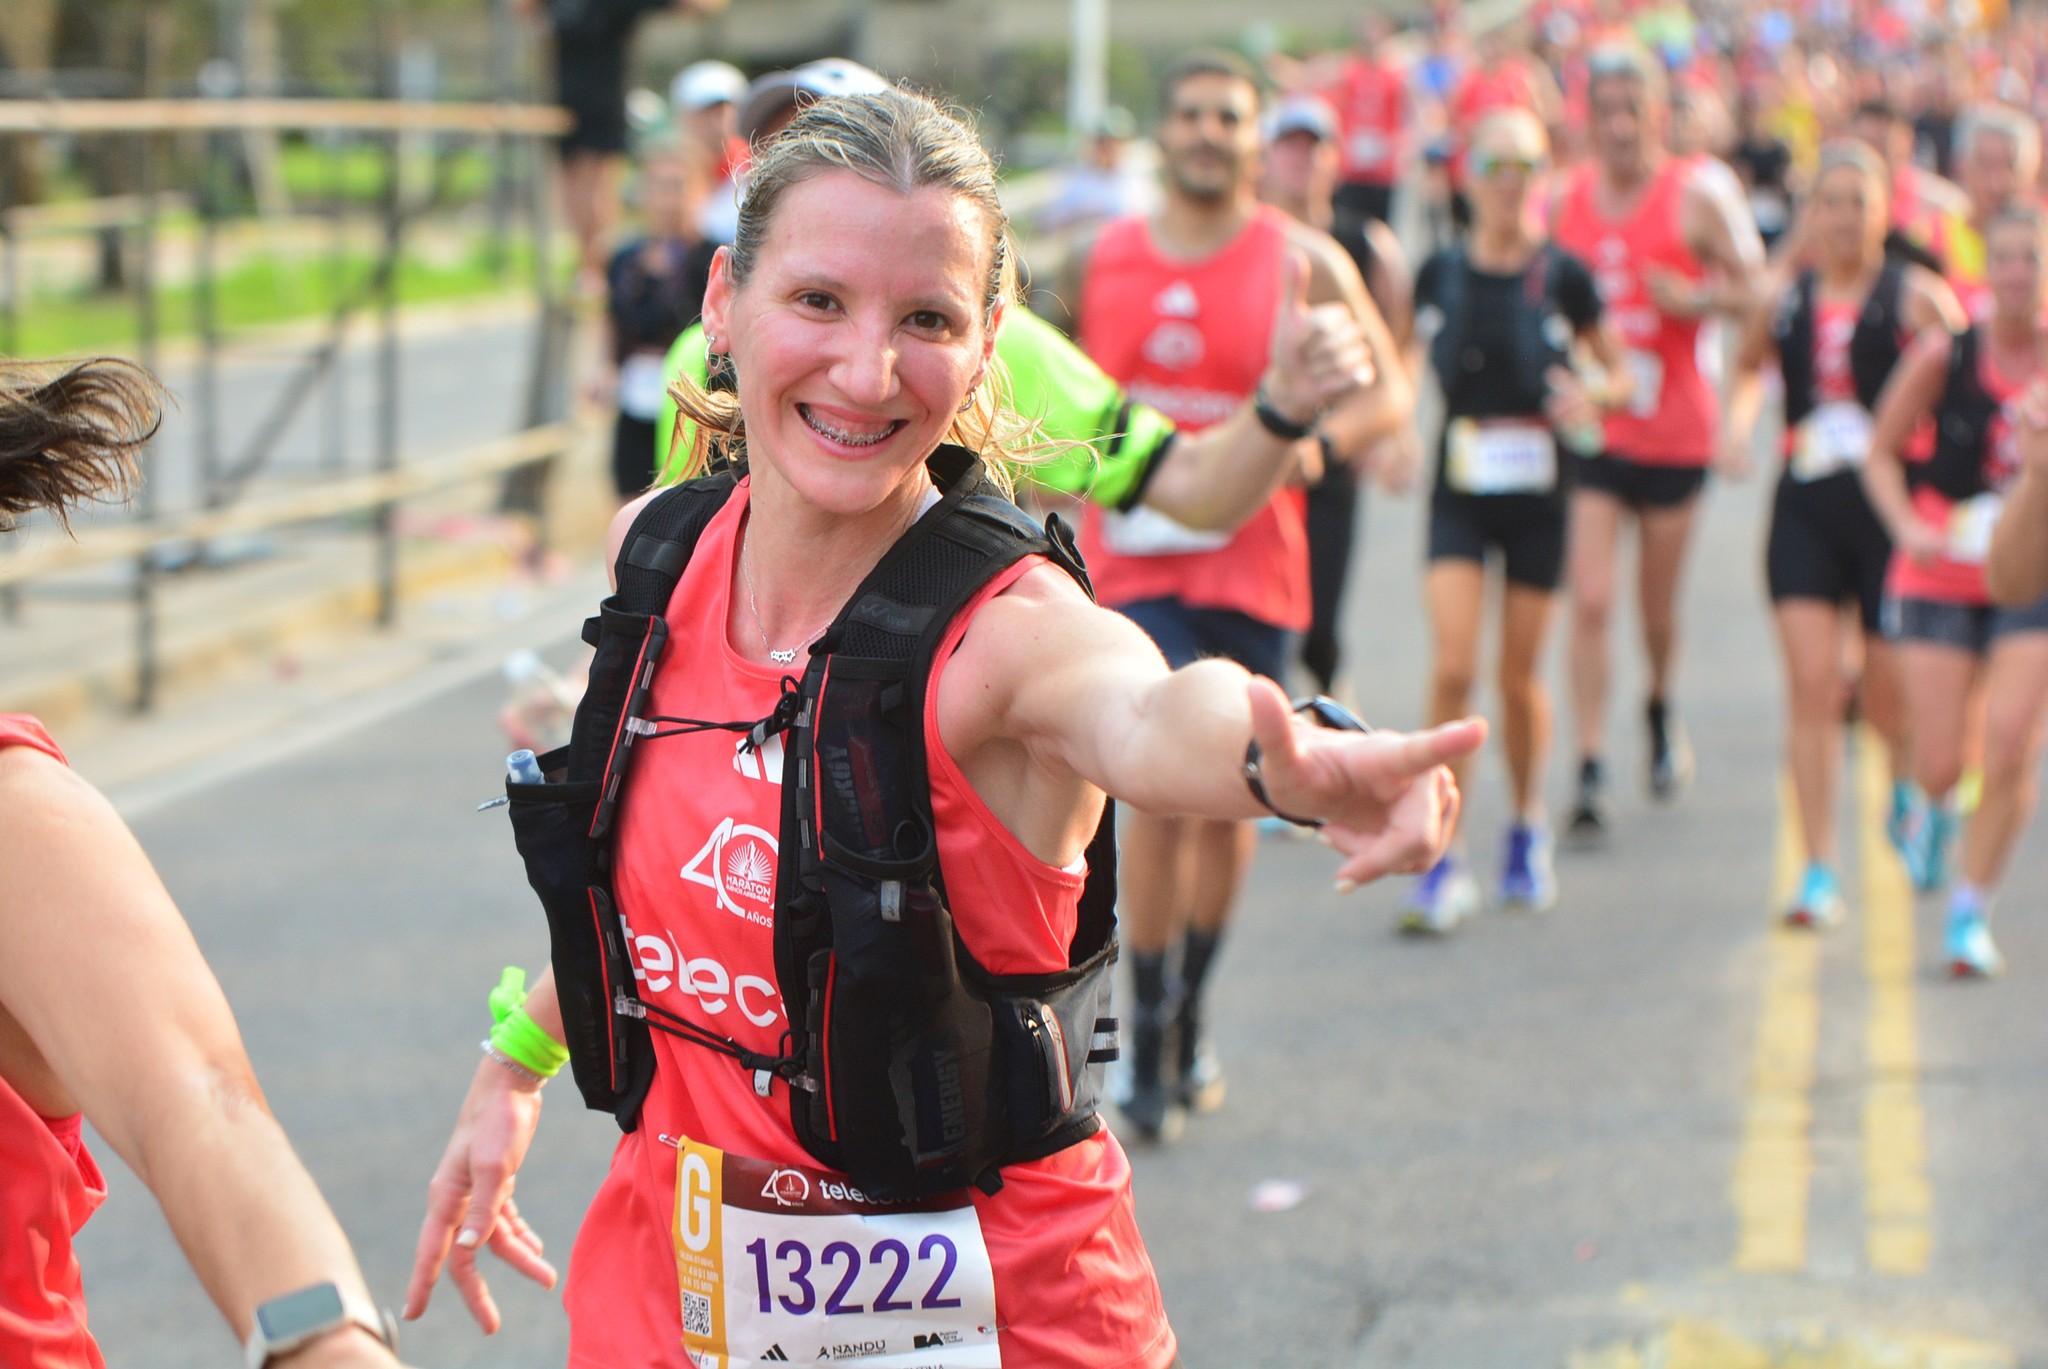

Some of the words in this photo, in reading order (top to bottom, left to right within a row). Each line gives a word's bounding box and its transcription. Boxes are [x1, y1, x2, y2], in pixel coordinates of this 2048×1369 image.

[726, 874, 771, 898] MARATON
[746, 911, 773, 928] AÑOS
[619, 914, 790, 1027] telec
[680, 1153, 711, 1252] G
[746, 1234, 962, 1316] 13222
[913, 1332, 944, 1349] BA
